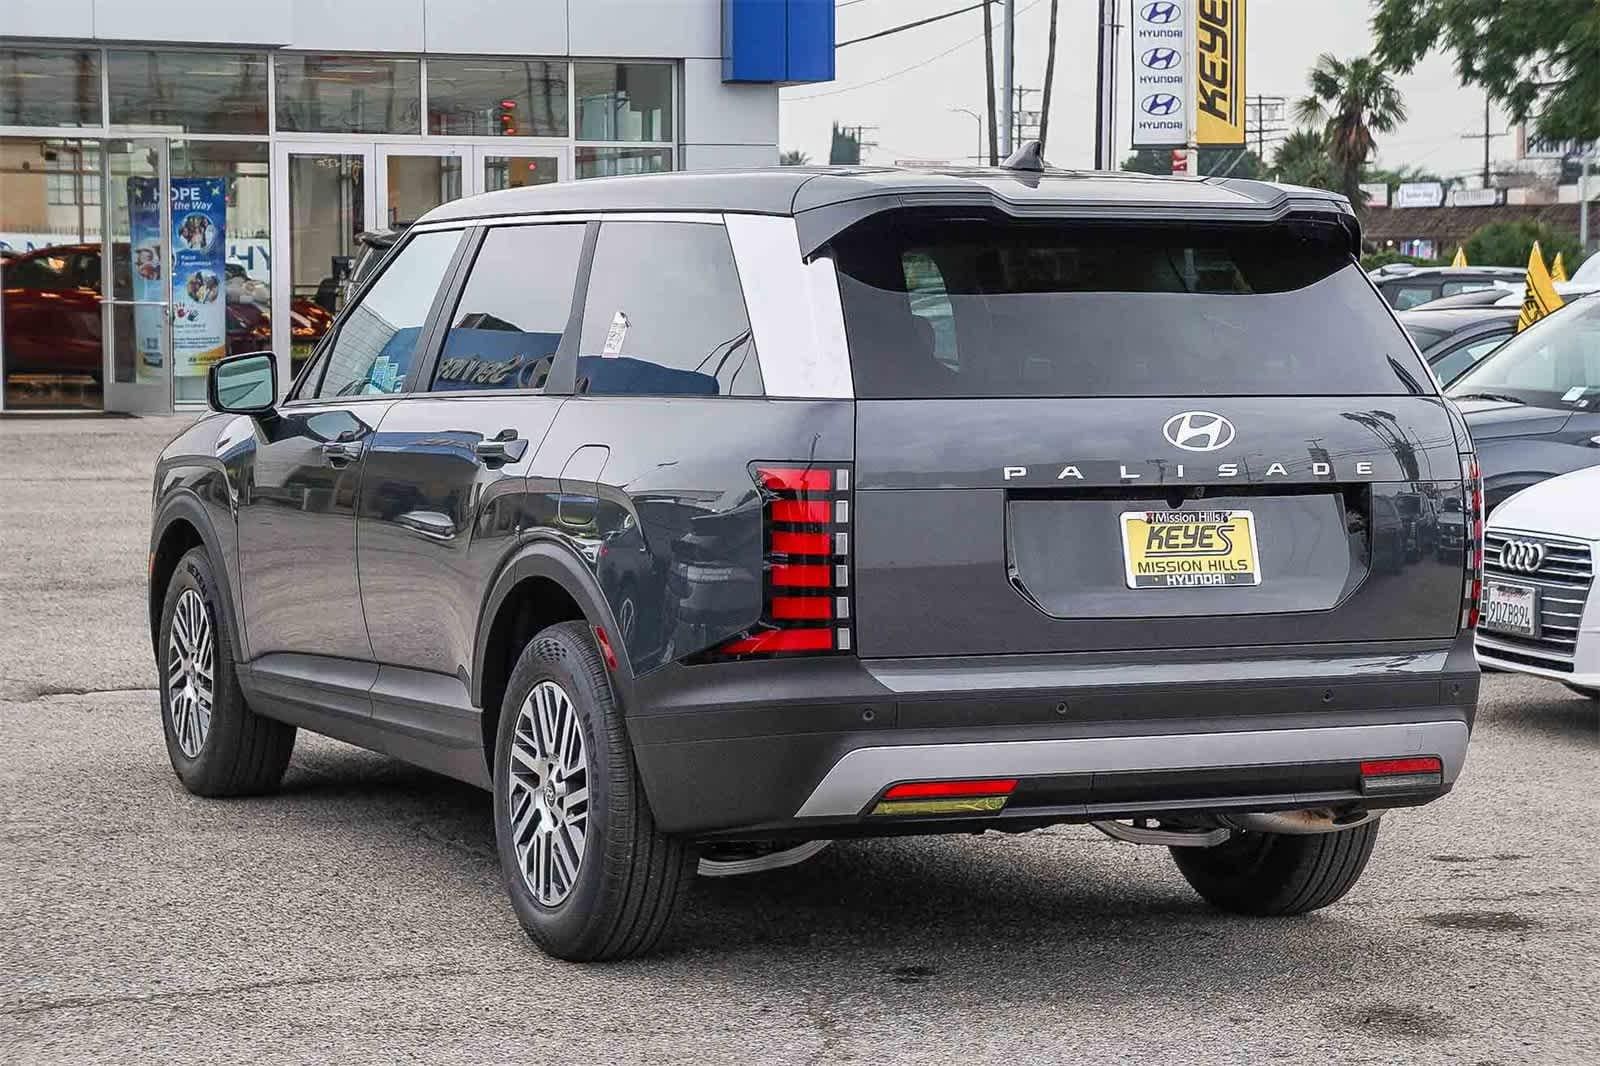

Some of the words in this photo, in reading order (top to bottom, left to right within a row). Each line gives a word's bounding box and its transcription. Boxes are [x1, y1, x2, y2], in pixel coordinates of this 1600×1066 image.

[1139, 29, 1183, 38] HYUNDAI
[1140, 75, 1183, 84] HYUNDAI
[1139, 121, 1183, 129] HYUNDAI
[174, 201, 190, 210] the
[192, 201, 213, 211] Way
[1004, 462, 1373, 480] PALISADE
[1155, 512, 1196, 523] Mission
[1200, 511, 1221, 522] Hills
[1144, 525, 1236, 558] KEYES
[1137, 560, 1202, 573] MISSION
[1208, 560, 1248, 571] HILLS
[1167, 574, 1226, 585] HYUNDAI
